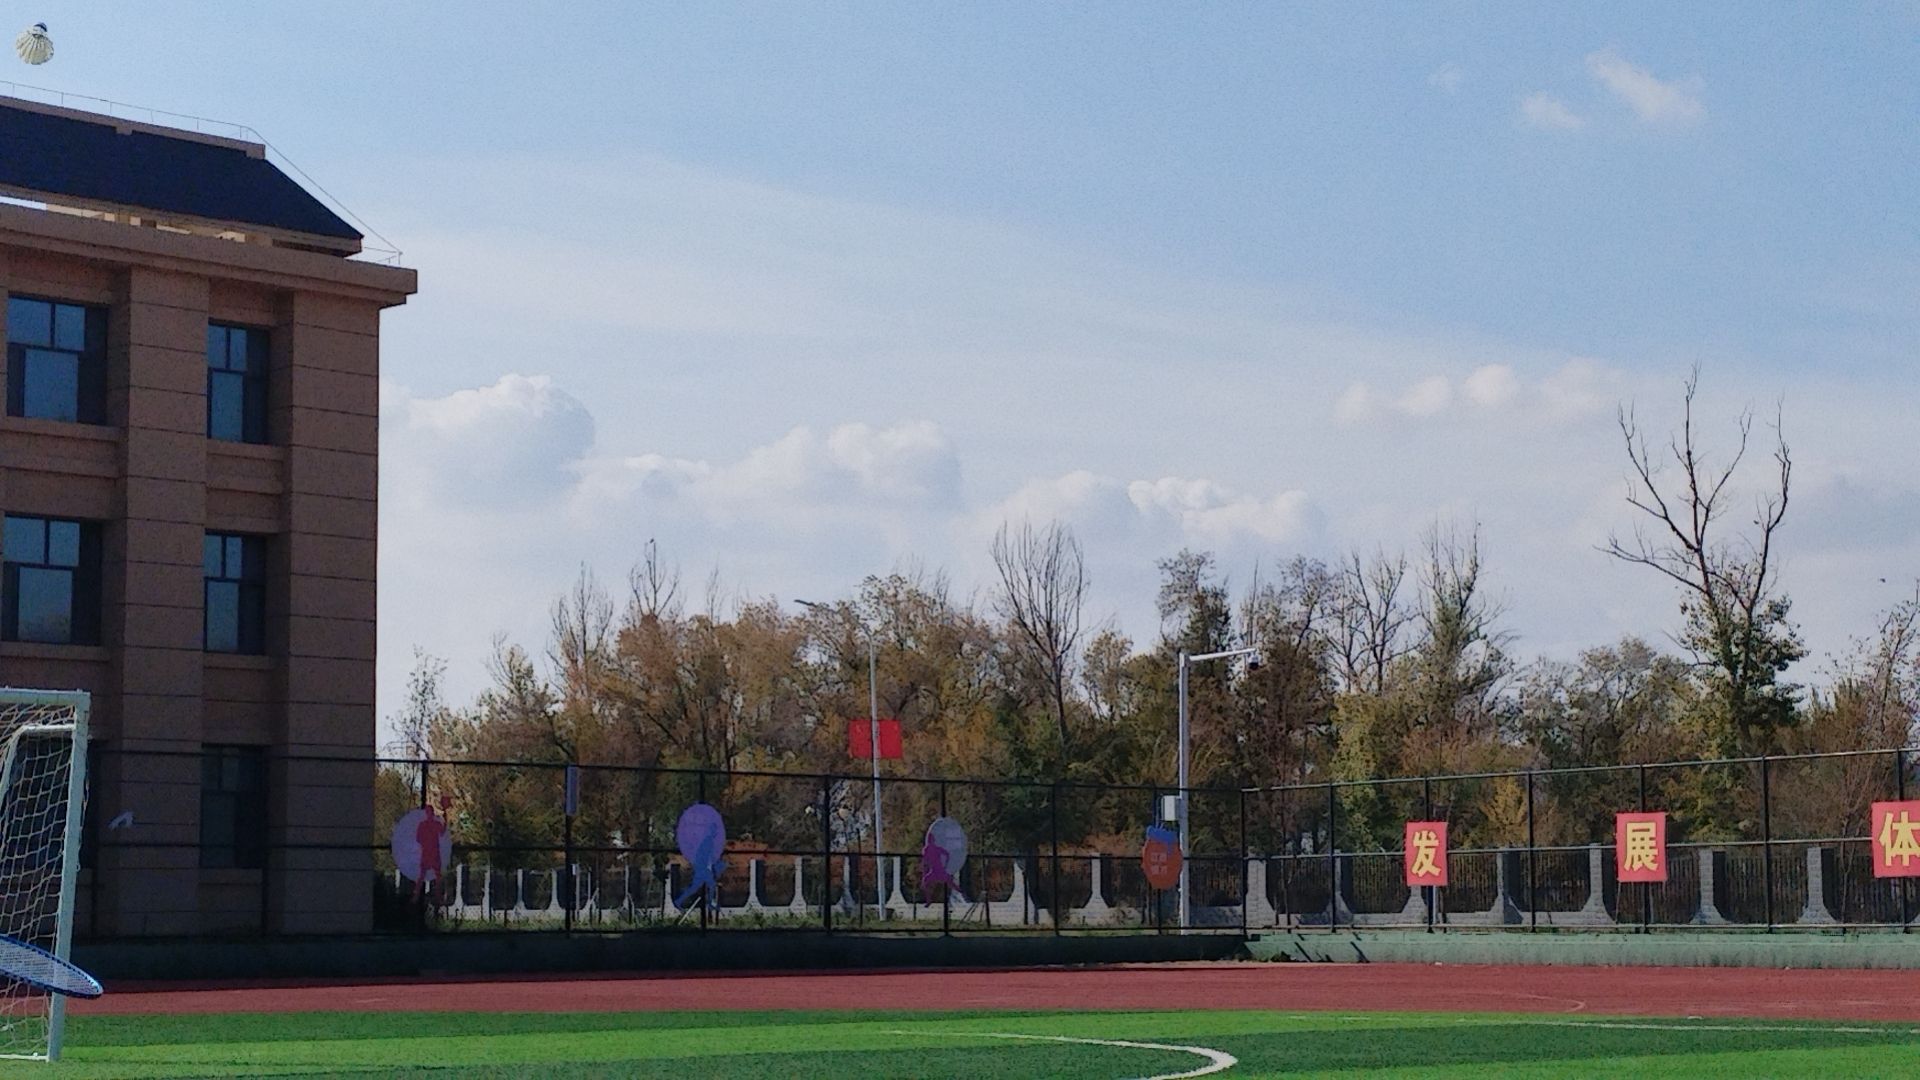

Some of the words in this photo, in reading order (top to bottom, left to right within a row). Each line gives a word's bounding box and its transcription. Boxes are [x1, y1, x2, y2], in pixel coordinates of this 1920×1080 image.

[1411, 830, 1441, 877] 发
[1624, 822, 1658, 871] 展
[1879, 811, 1920, 866] 体
